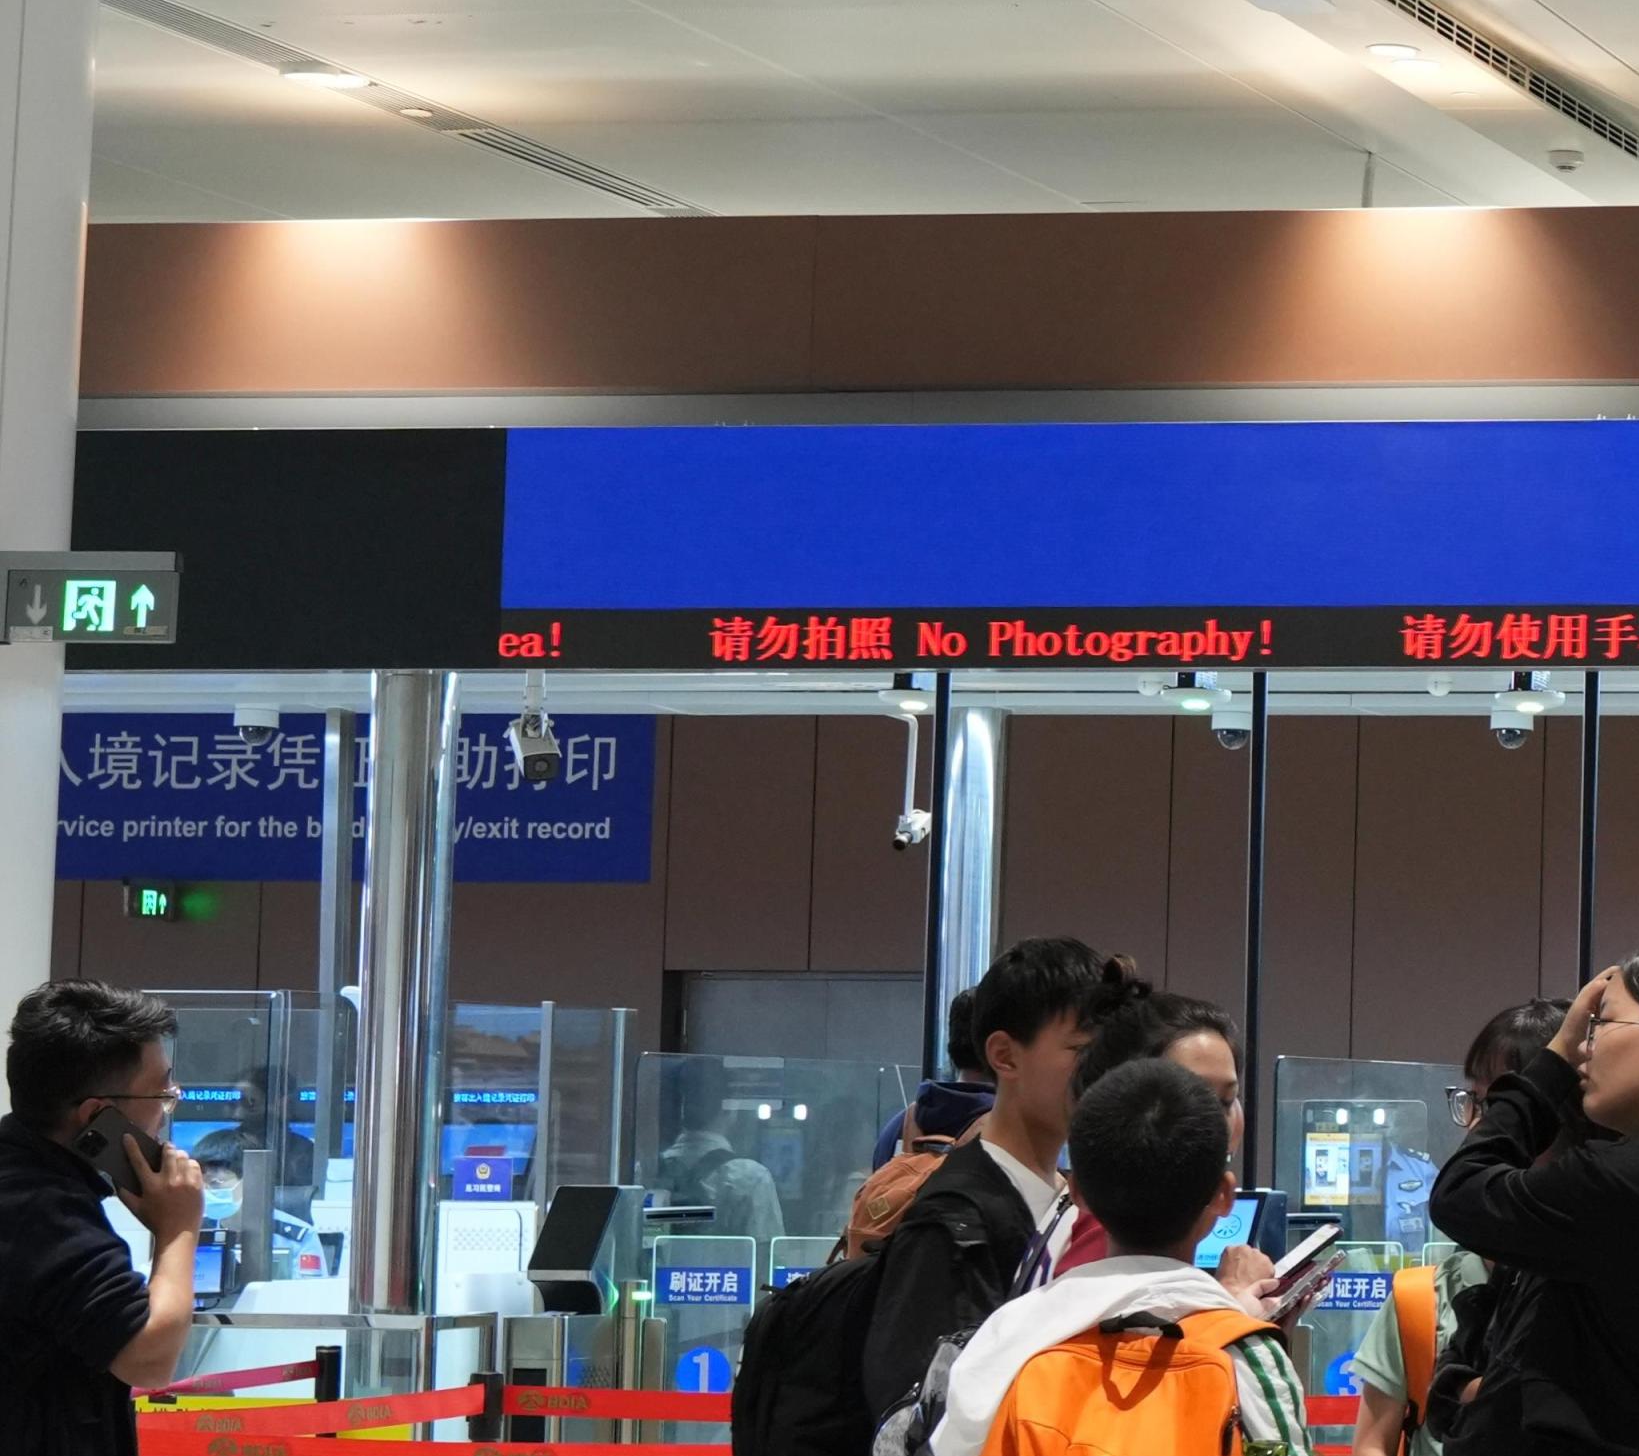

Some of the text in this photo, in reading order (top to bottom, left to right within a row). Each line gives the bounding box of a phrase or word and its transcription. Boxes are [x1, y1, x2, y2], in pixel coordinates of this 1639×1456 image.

[498, 622, 562, 658] ea!
[709, 616, 1273, 661] 请勿拍照 No Photography!
[57, 815, 115, 838] rvice
[123, 815, 208, 843] printer
[215, 815, 251, 838] for
[258, 815, 298, 838] the
[453, 816, 519, 843] y/exit
[527, 816, 611, 839] record
[669, 1271, 738, 1293] 刷证开启
[668, 1294, 685, 1302] Scan
[687, 1294, 702, 1302] Your
[1353, 1300, 1386, 1309] Certificat
